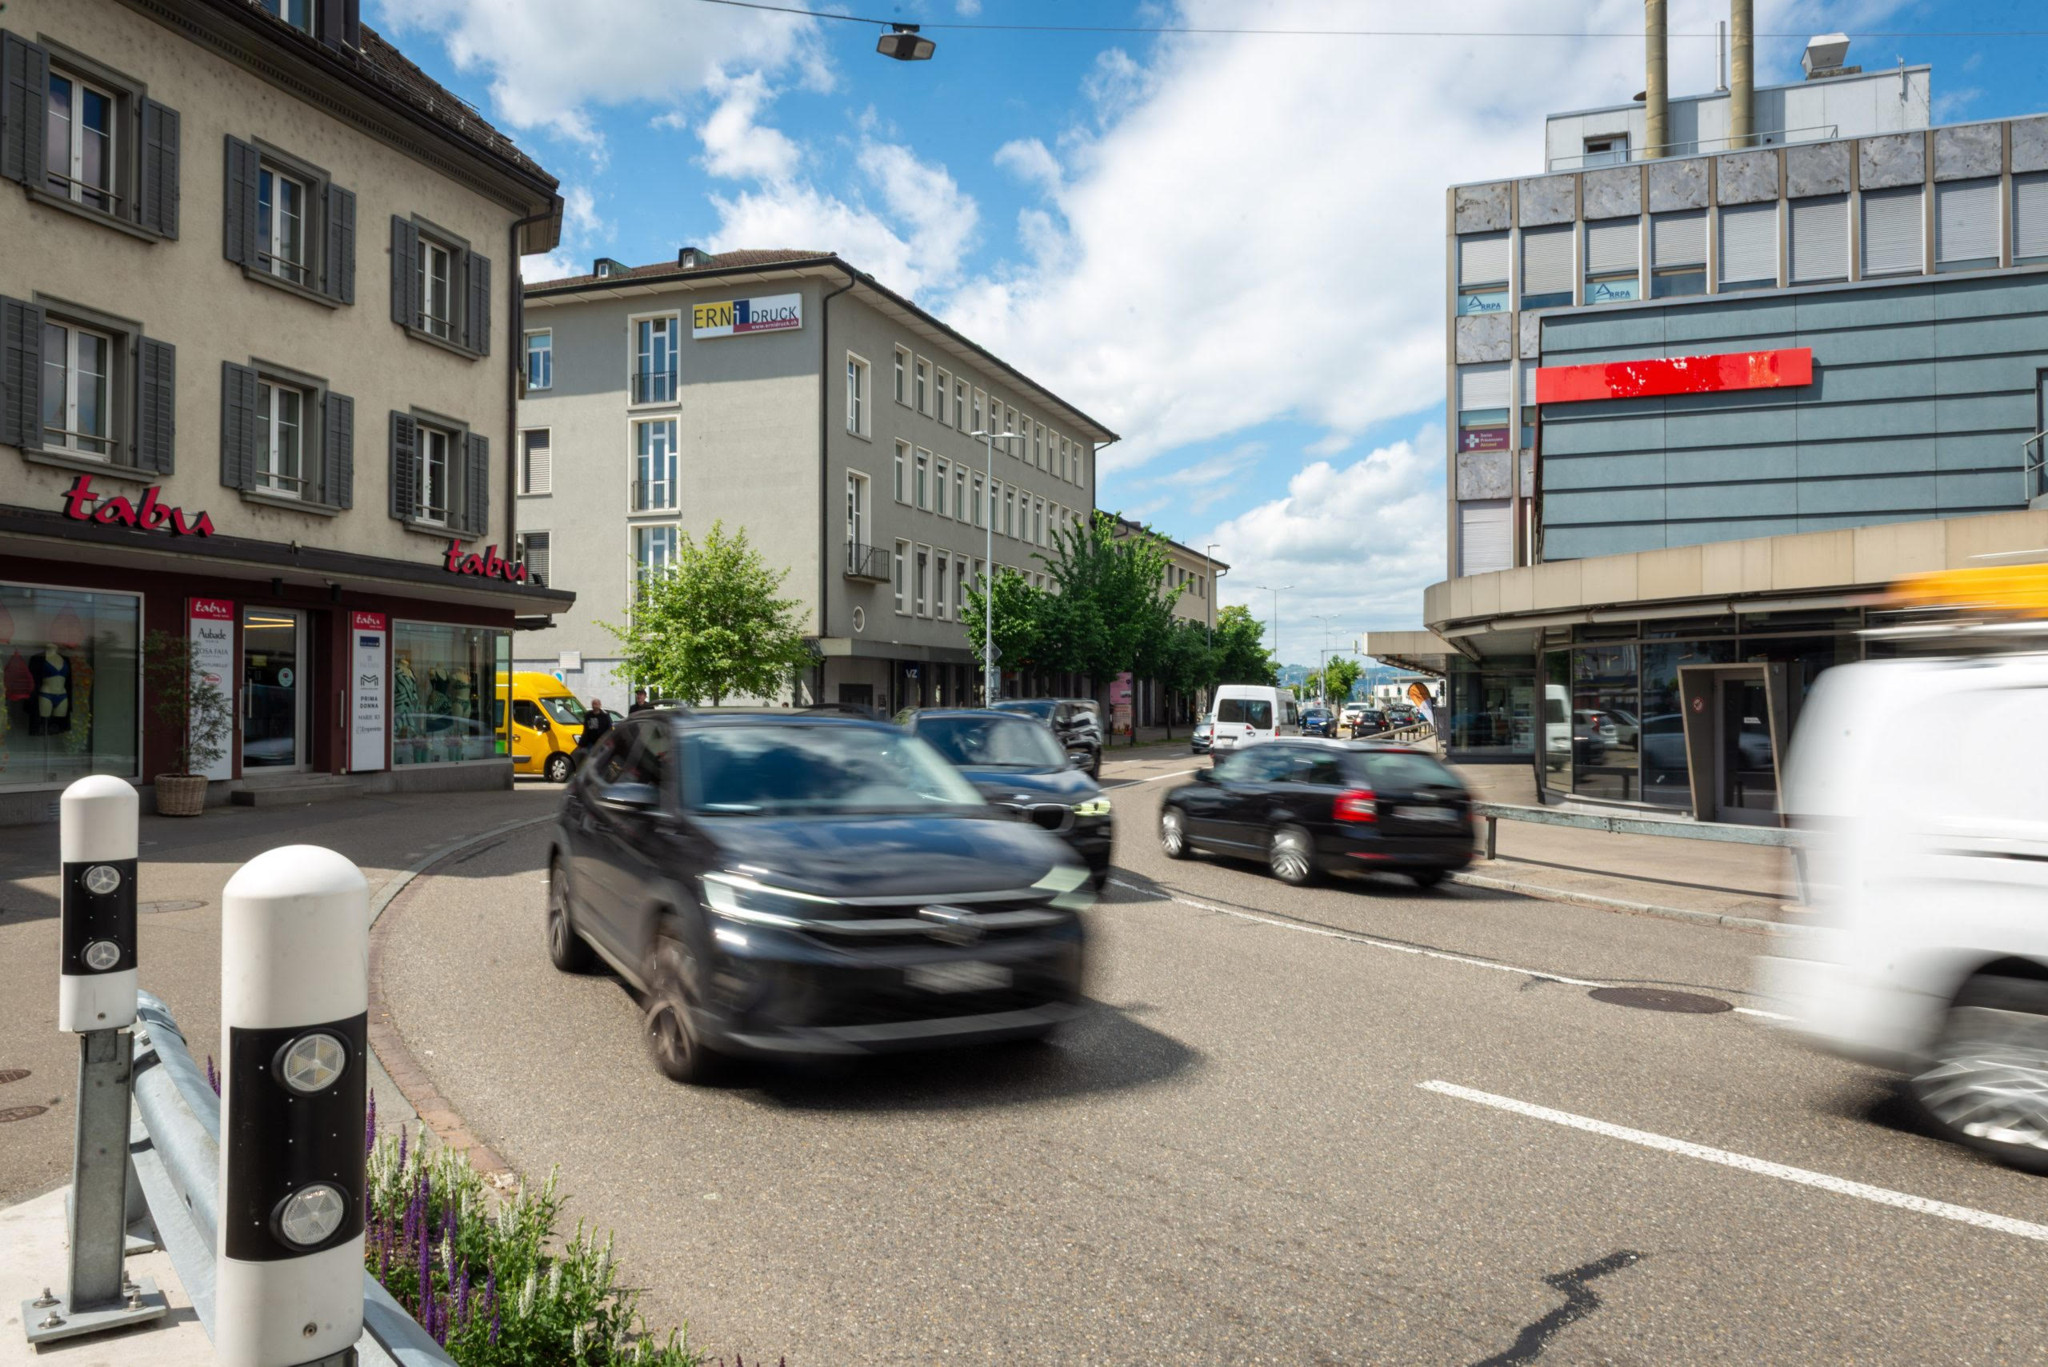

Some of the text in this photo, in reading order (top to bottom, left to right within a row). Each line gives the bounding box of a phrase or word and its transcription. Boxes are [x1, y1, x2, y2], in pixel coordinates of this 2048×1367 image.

[751, 305, 798, 324] DRUCK
[751, 320, 798, 329] www.ernidruck.ch
[62, 474, 215, 537] tabu
[442, 538, 527, 581] tabu
[195, 601, 226, 613] tabu
[356, 613, 380, 625] tabu
[198, 628, 227, 640] Aubade
[905, 668, 918, 679] VZ
